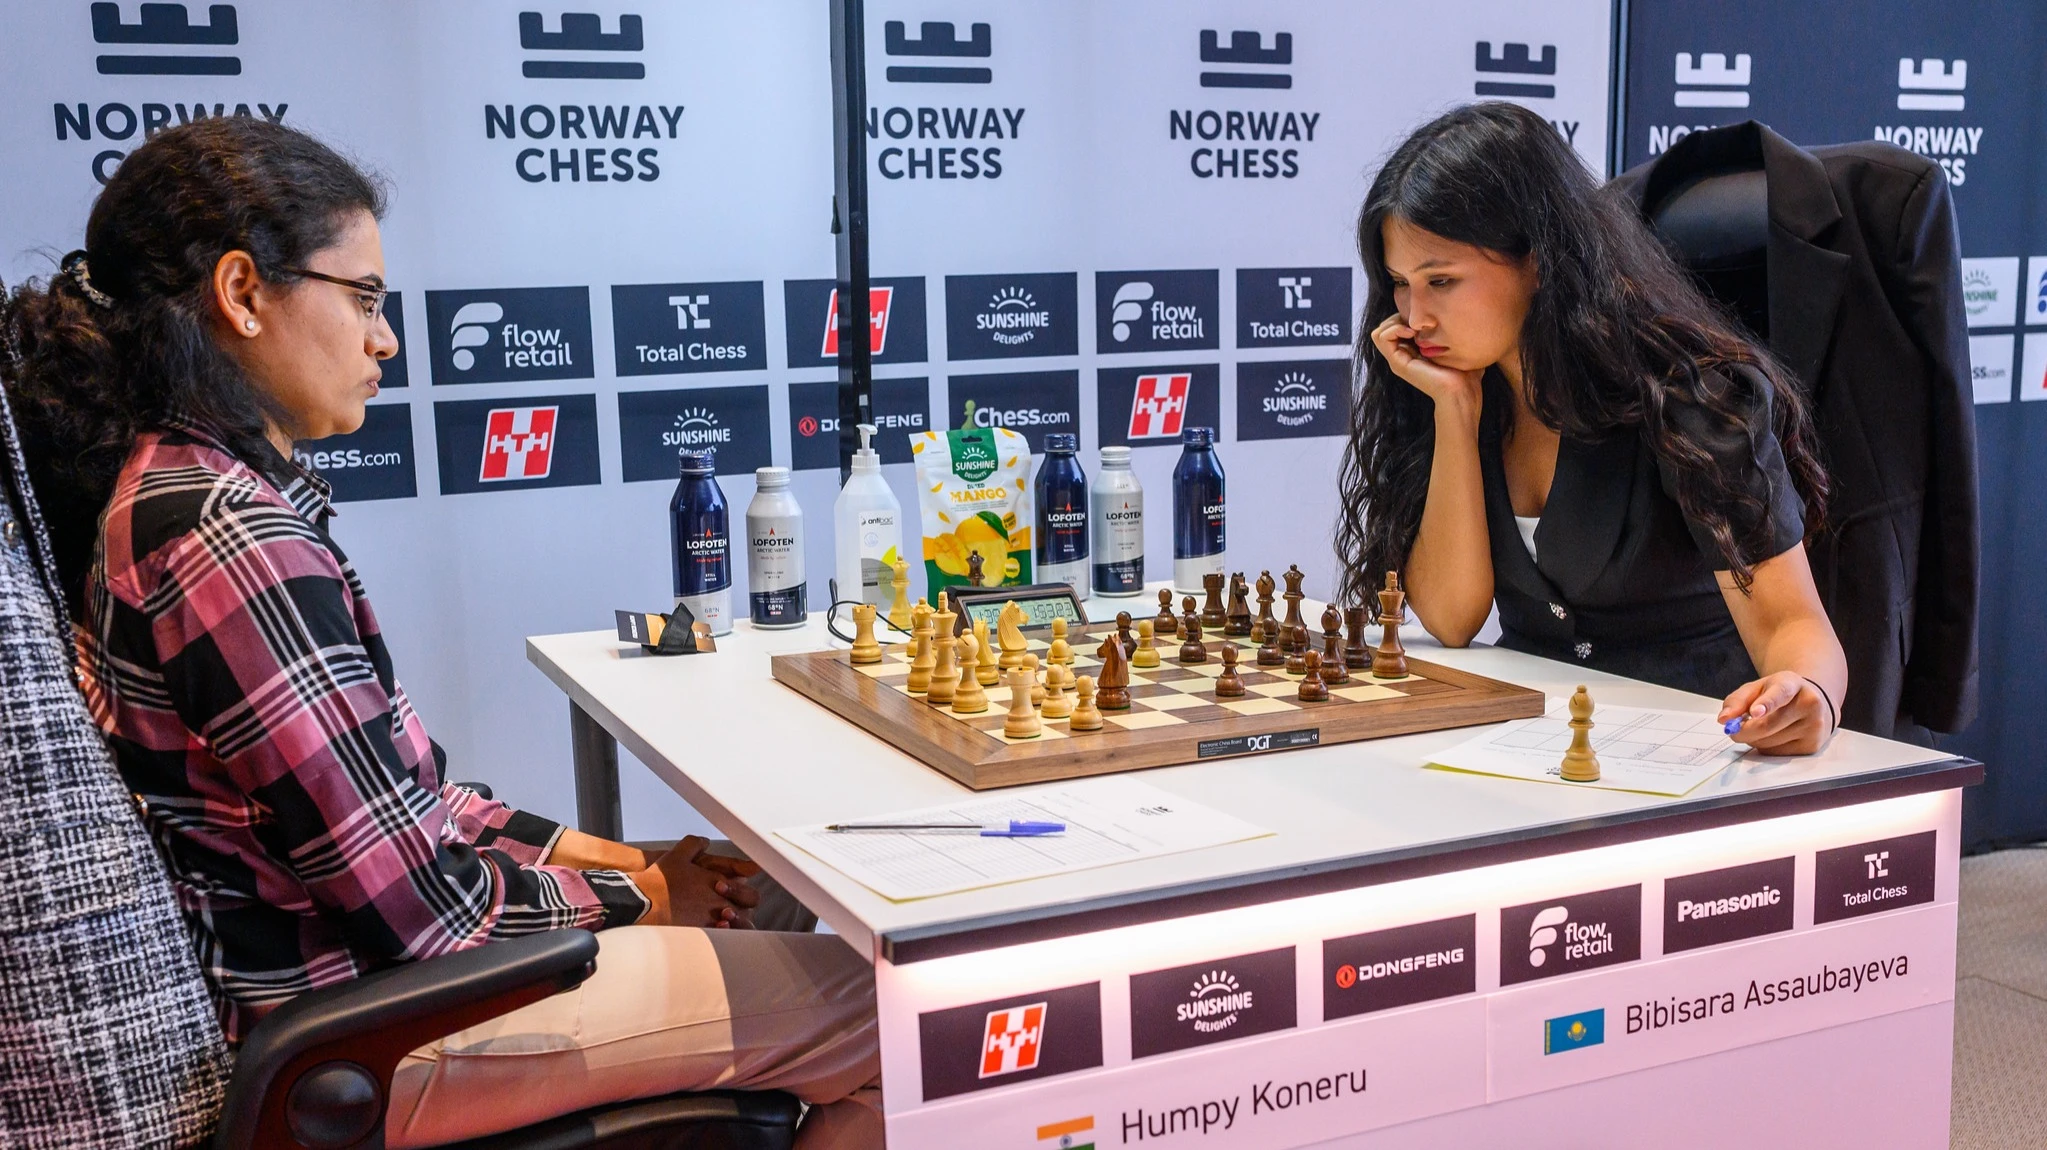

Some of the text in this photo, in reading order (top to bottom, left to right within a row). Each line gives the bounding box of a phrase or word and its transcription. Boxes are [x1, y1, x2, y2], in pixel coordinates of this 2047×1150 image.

[484, 104, 685, 140] NORWAY
[866, 107, 1025, 140] NORWAY
[1169, 109, 1320, 142] NORWAY
[1874, 125, 1984, 155] NORWAY
[515, 147, 660, 183] CHESS
[878, 146, 1003, 180] CHESS
[1190, 148, 1300, 179] CHESS
[976, 311, 1049, 330] SUNSHINE
[1151, 301, 1196, 323] flow
[502, 323, 560, 348] flow
[993, 330, 1035, 345] DELIGHTS
[1152, 318, 1205, 341] retail
[1250, 320, 1340, 338] Total Chess
[505, 343, 573, 369] retail
[636, 342, 747, 363] Total Chess
[1263, 394, 1327, 412] SUNSHINE
[974, 407, 1070, 427] Chess.com
[1277, 412, 1314, 427] DELIGHTS
[662, 427, 731, 447] SUNSHINE
[293, 447, 401, 470] hess.com
[955, 459, 995, 471] SUNSHINE
[950, 487, 1007, 503] MANGO
[1048, 512, 1086, 522] LOFOTEN
[1106, 511, 1141, 520] LOFOTEN
[687, 538, 727, 549] LOFOTEN
[753, 537, 794, 546] LOFOTEN
[1247, 734, 1272, 751] DGT
[1677, 885, 1781, 923] Panasonic
[1842, 882, 1907, 907] Total Chess
[1564, 920, 1606, 945] flow
[1565, 933, 1613, 961] retail
[1358, 948, 1464, 981] DONGFENG
[1626, 954, 1909, 1035] Bibisara Assaubayeva
[1177, 991, 1253, 1023] SUNSHINE
[1194, 1013, 1236, 1033] DELIGHTS
[1121, 1067, 1369, 1144] Humpy Koneru
